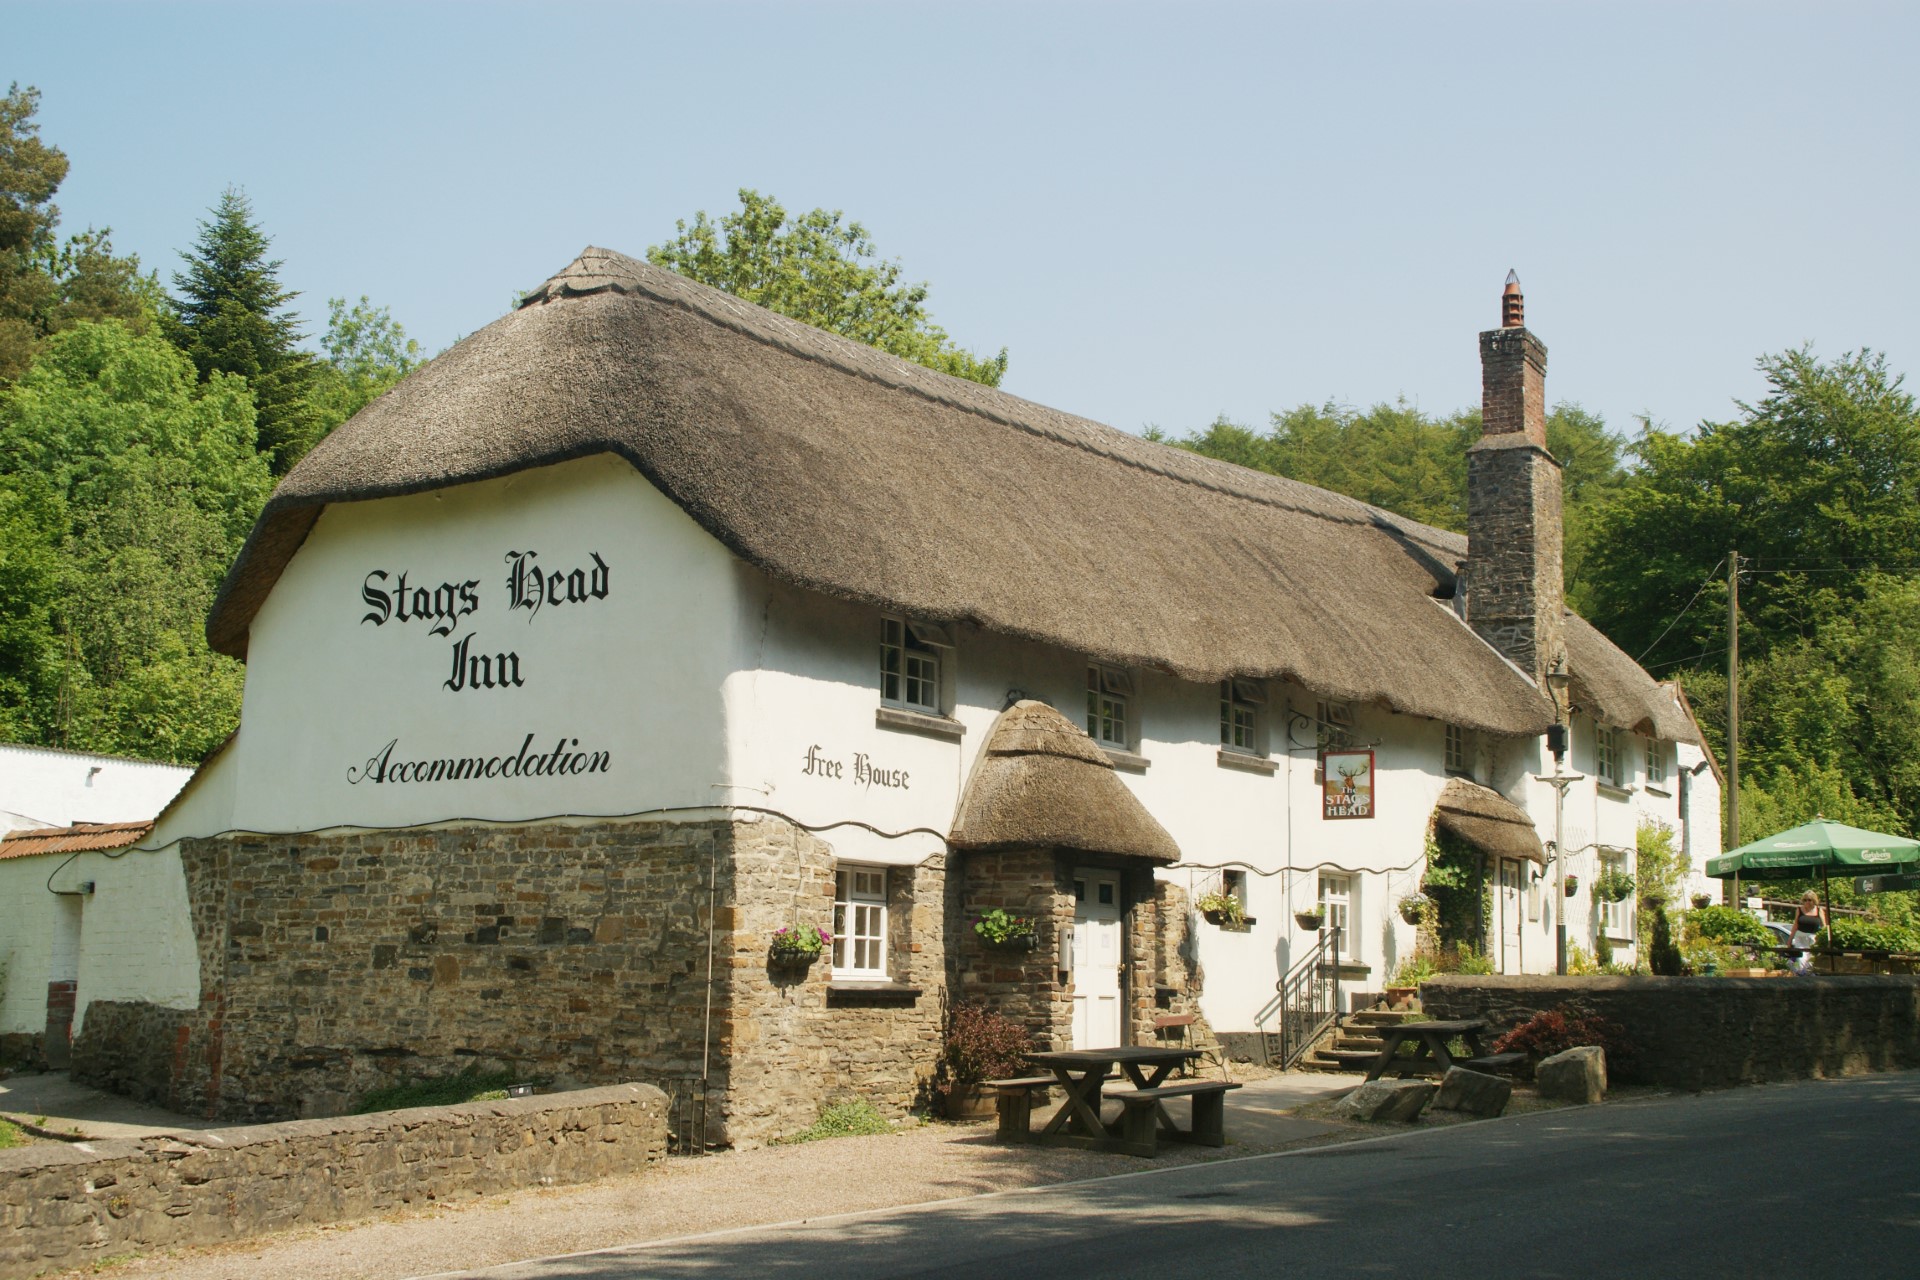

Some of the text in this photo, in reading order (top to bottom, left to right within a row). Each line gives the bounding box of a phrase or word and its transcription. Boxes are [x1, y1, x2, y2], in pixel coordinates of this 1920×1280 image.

[360, 550, 610, 637] Stags Head
[442, 632, 525, 692] Inn
[347, 733, 612, 785] Accommodation
[802, 744, 910, 795] Free House
[1328, 806, 1367, 816] HEAD
[1341, 786, 1357, 794] The
